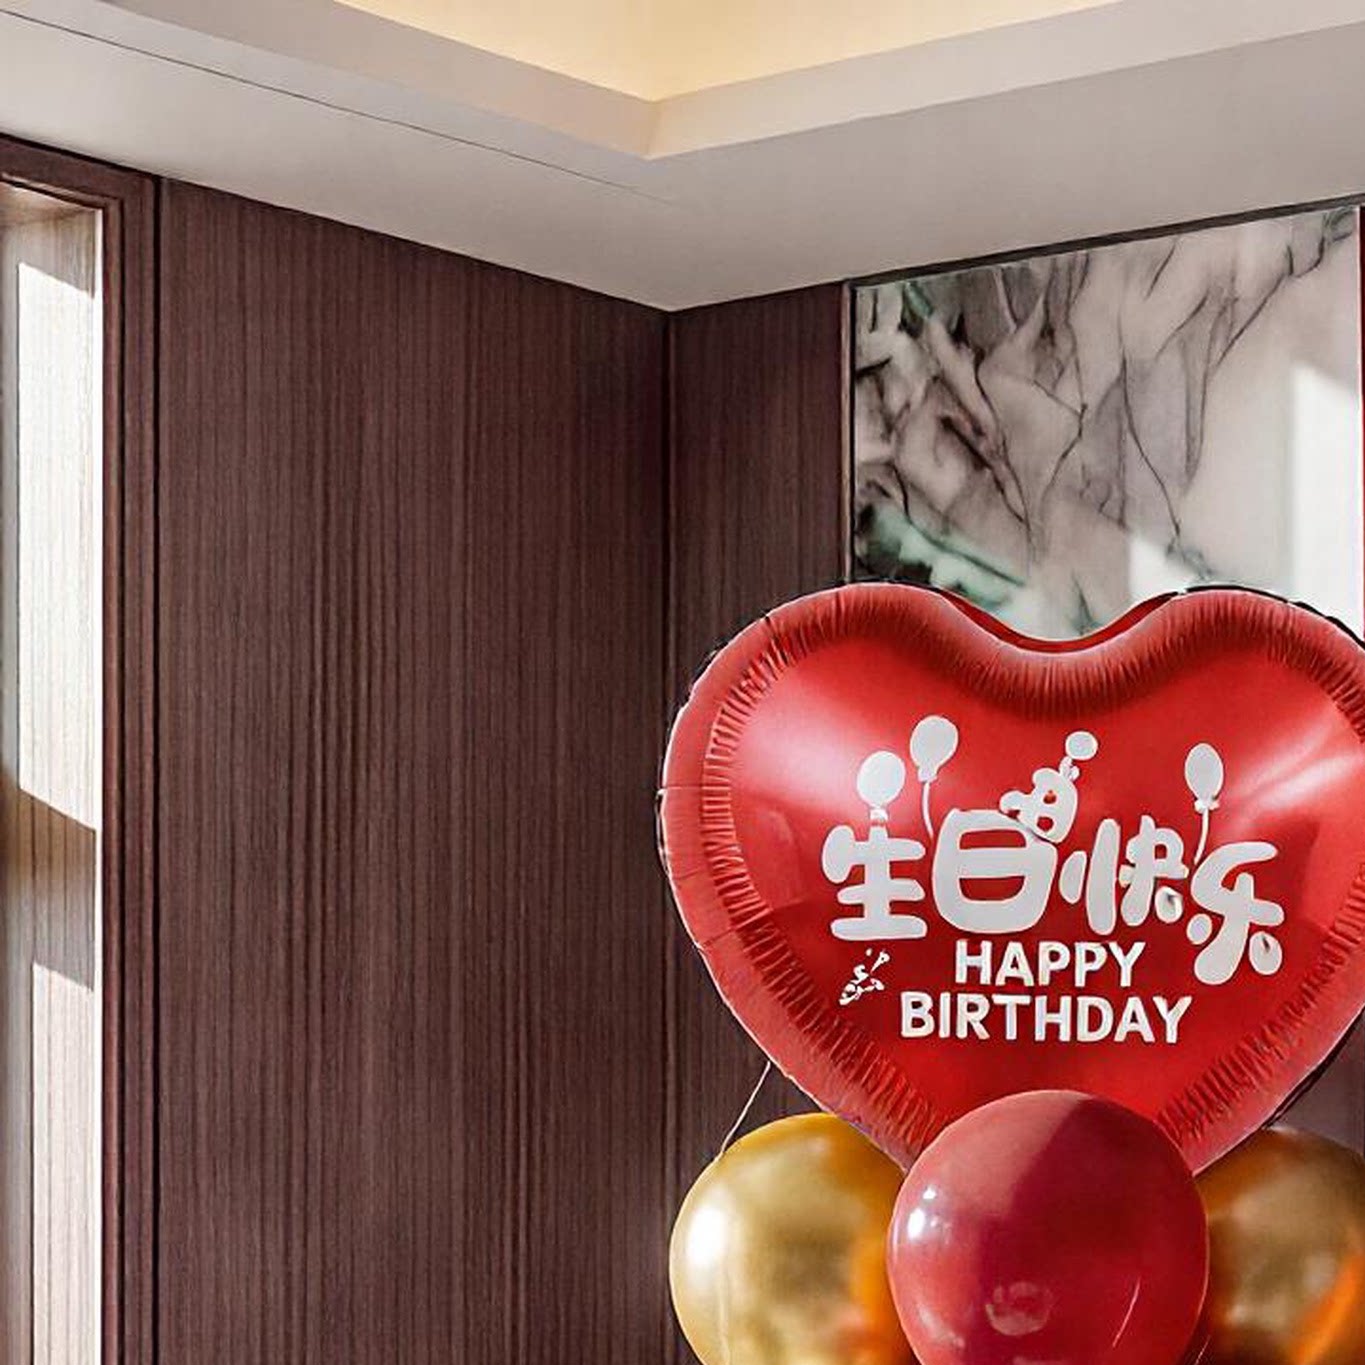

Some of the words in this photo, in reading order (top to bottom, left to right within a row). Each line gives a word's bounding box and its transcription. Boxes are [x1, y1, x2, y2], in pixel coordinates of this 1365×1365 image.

[822, 808, 1285, 985] 生日快乐
[954, 940, 1147, 988] HAPPY
[901, 990, 1193, 1044] BIRTHDAY
